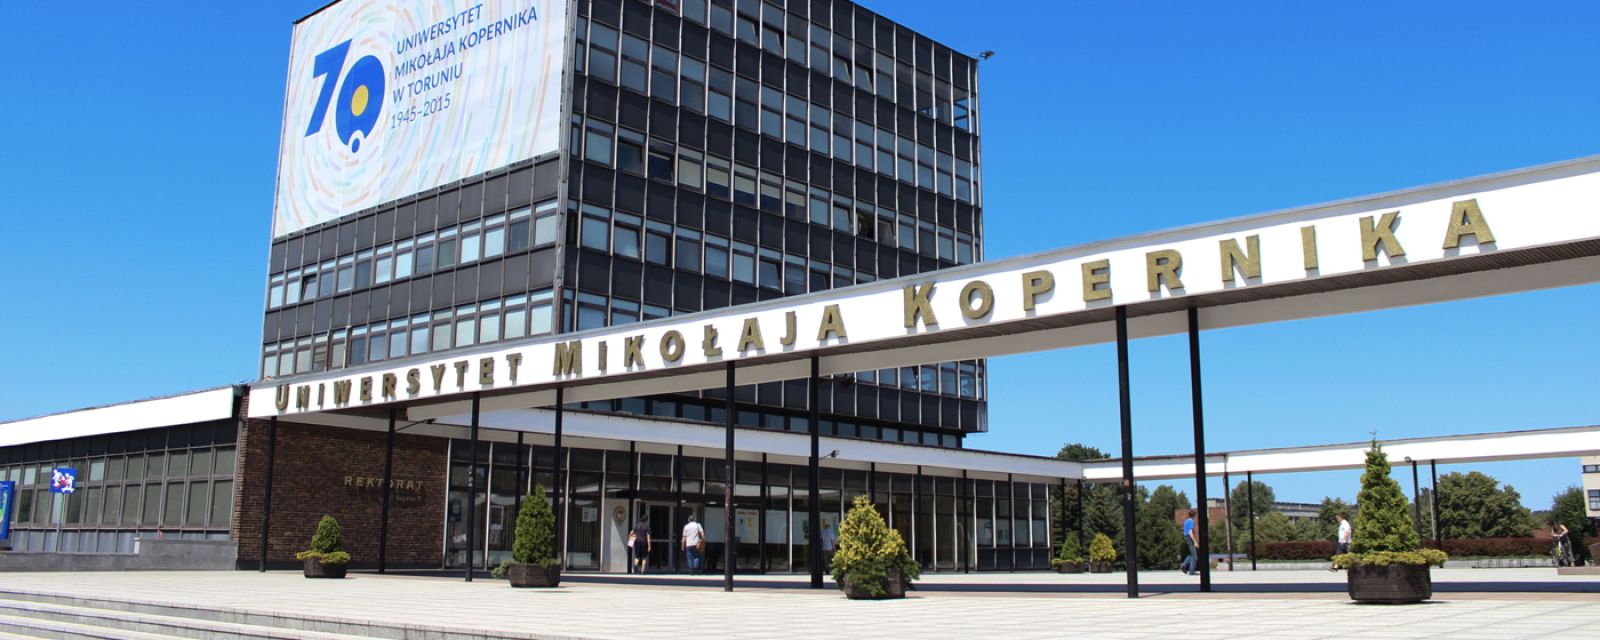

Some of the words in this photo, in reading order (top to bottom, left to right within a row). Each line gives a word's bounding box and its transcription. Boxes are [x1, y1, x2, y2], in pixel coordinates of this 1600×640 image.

[393, 43, 456, 80] MIKOŁAJA
[458, 6, 538, 52] KOPERNIKA
[396, 3, 484, 55] UNIWERSYTET
[304, 38, 386, 154] 70
[392, 86, 405, 104] W
[407, 62, 464, 97] TORUNIU
[276, 352, 523, 411] UNIWERSYTET
[552, 303, 848, 377] MIKOŁAJA
[902, 198, 1496, 329] KOPERNIKA
